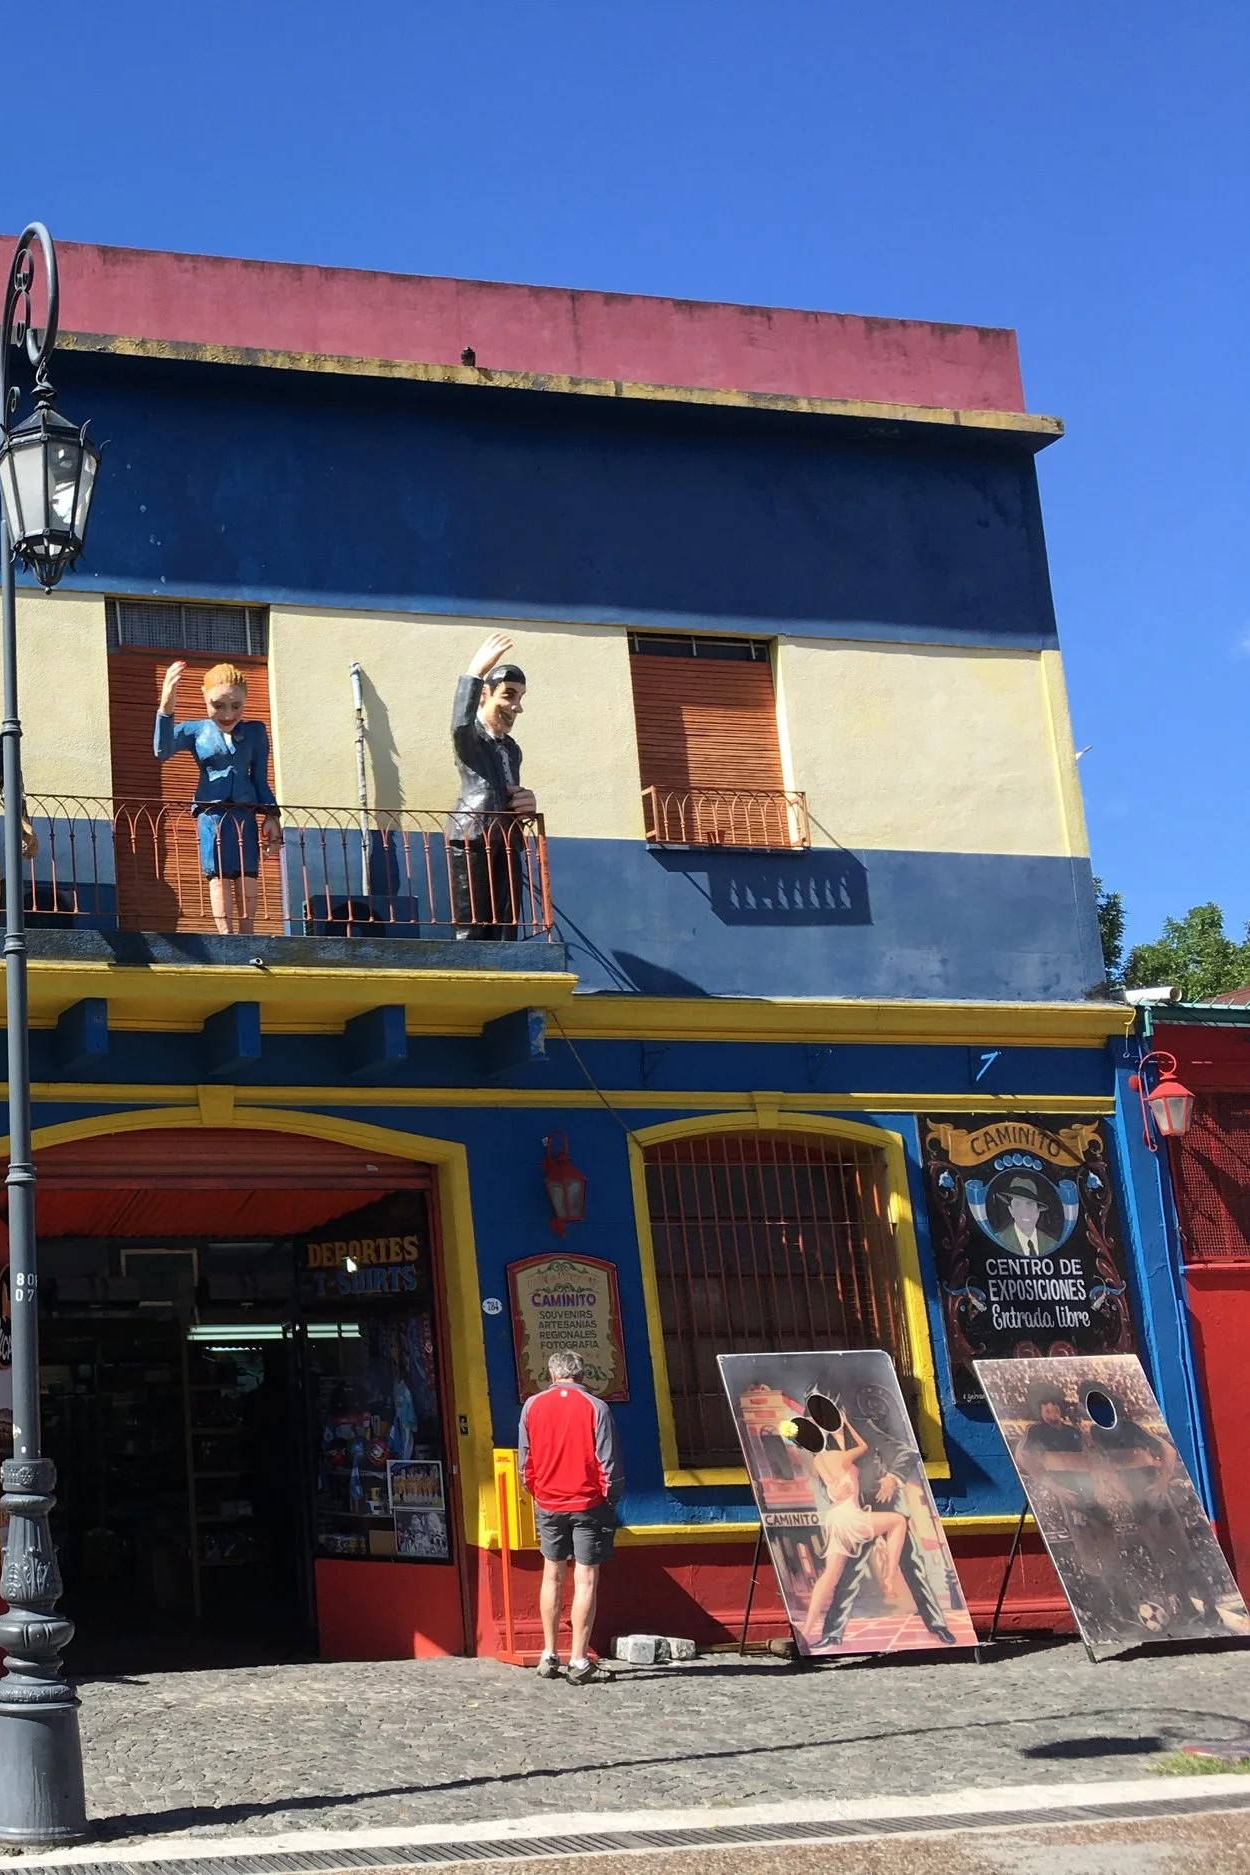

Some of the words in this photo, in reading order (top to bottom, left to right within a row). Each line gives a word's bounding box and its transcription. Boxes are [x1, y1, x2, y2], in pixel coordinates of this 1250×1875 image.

[970, 1126, 1061, 1158] CAMINITO
[307, 1235, 419, 1268] DEPORTES
[986, 1259, 1054, 1276] CENTRO
[1060, 1259, 1083, 1275] DE
[314, 1264, 417, 1295] T-SHIRTS
[988, 1279, 1086, 1301] EXPOSICIONES
[531, 1293, 597, 1308] CAMINITO
[539, 1310, 593, 1320] SOUVENIRS
[992, 1305, 1054, 1329] Entrada
[1058, 1303, 1091, 1328] libre
[538, 1320, 598, 1331] ARTESANIAS
[539, 1331, 597, 1340] REGIONALES
[540, 1341, 600, 1350] FOTOGRAFIA
[765, 1514, 819, 1526] CAMINITO
